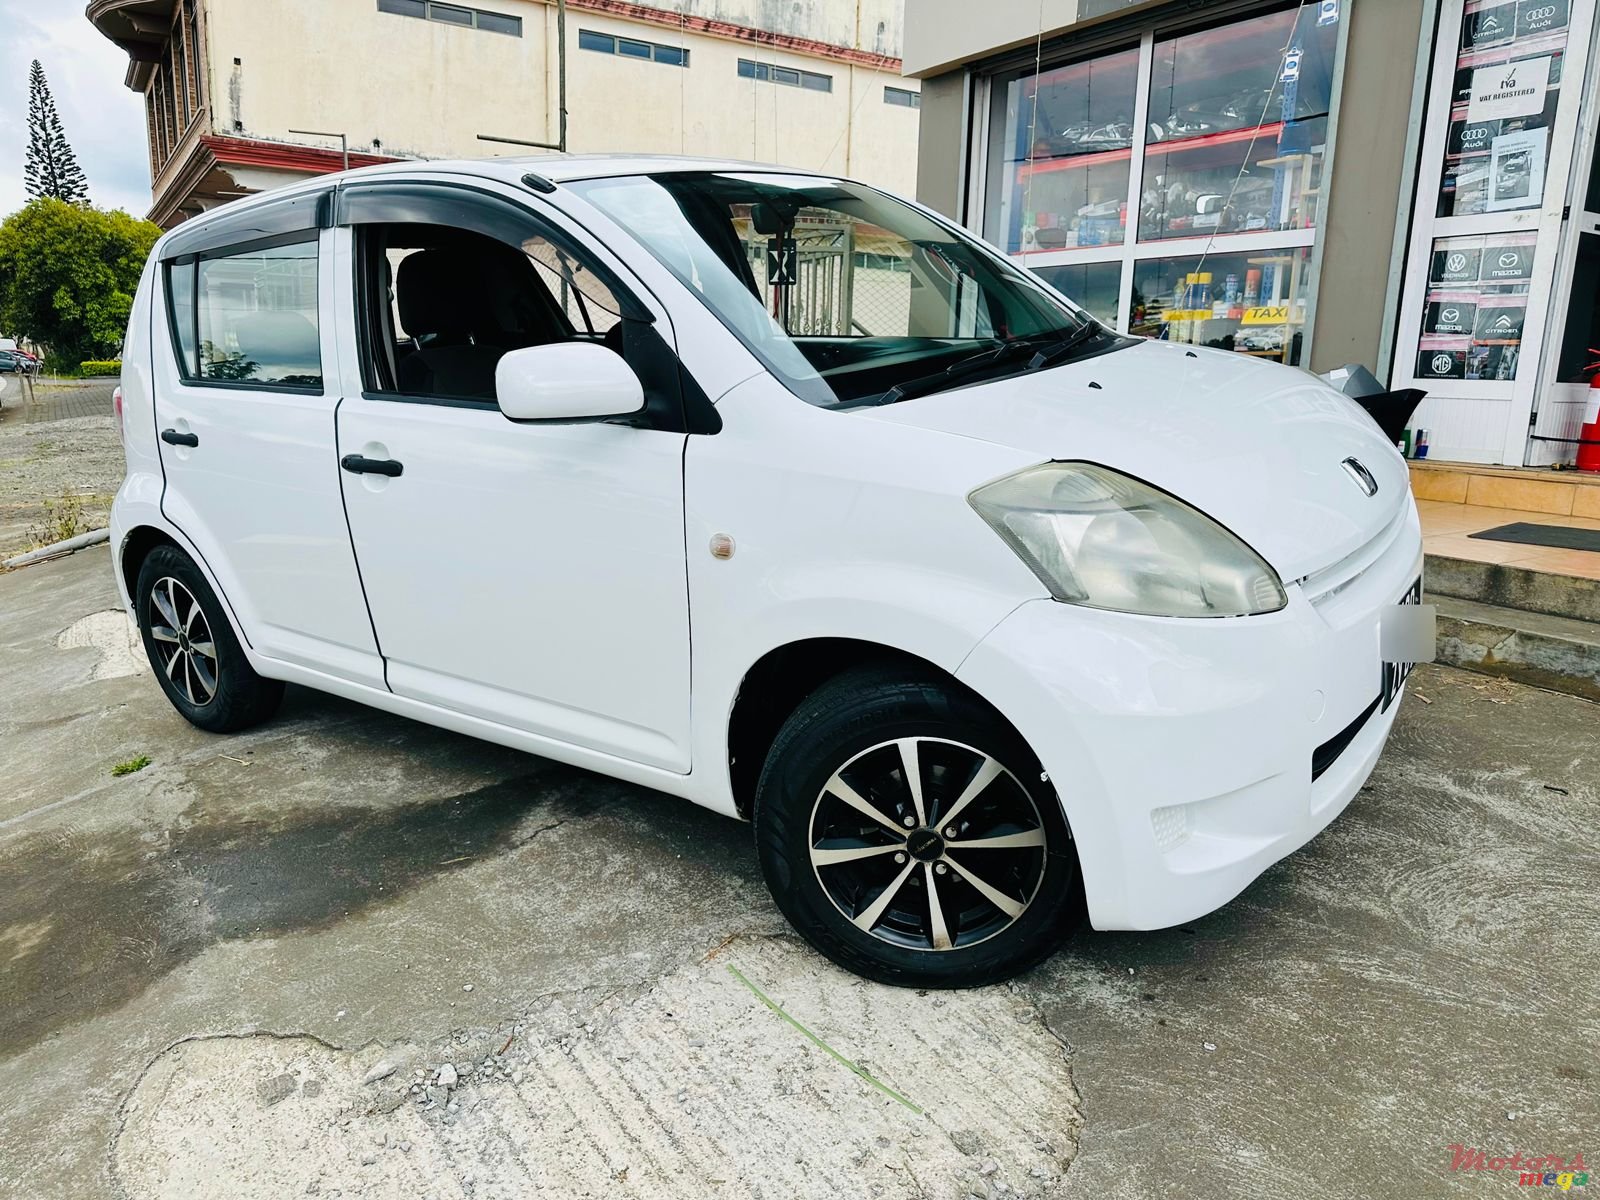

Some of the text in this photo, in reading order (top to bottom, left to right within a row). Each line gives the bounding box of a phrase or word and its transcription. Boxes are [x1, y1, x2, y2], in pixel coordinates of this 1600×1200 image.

[1529, 19, 1552, 30] Audi
[1479, 88, 1536, 102] VAT REGISTERED
[1463, 141, 1484, 149] Audi
[1433, 356, 1450, 372] MG
